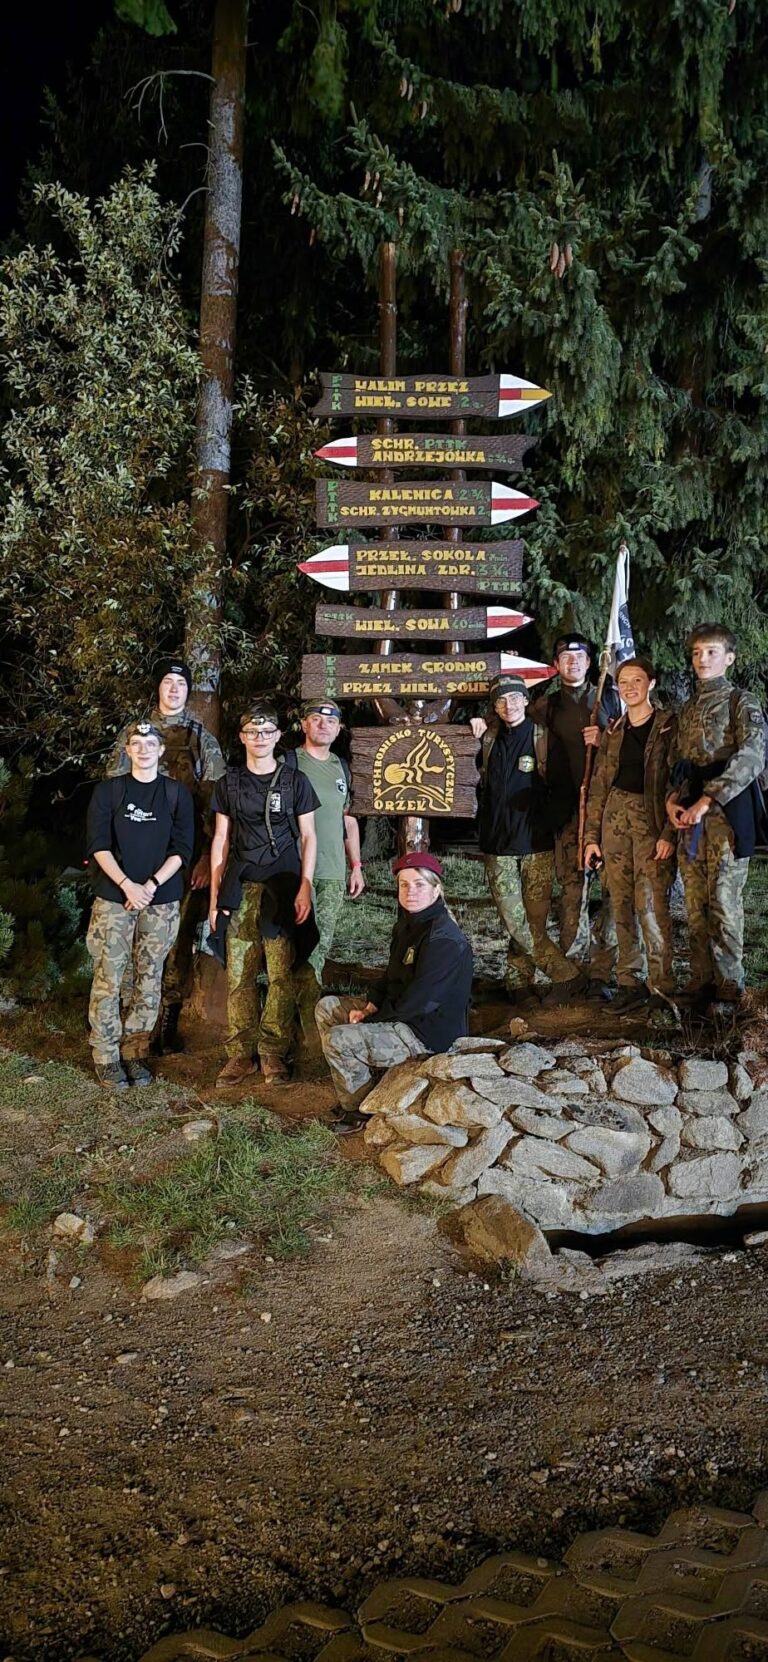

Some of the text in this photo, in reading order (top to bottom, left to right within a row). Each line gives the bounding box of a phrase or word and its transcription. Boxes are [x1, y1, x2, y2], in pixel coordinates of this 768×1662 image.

[331, 375, 342, 410] PTTK
[355, 380, 469, 393] WALIM PRZEZ
[406, 395, 452, 408] SOWE
[371, 438, 467, 450] SCHR. PTTK
[327, 481, 338, 522] PTTK
[369, 489, 454, 501] KALENICA
[340, 506, 381, 516] SCHR.
[356, 550, 417, 562] PRZEŁ.
[421, 550, 486, 561] SOKOLA
[356, 564, 427, 576] JEDLINA
[437, 564, 476, 576] ZDR.
[478, 581, 522, 592] PTTK
[355, 619, 400, 632] WIEL.
[405, 618, 450, 631] SOWA
[358, 660, 487, 675] ZAMEK GRODNO
[325, 656, 337, 697] PTTK
[342, 682, 490, 694] PRZEZ WIEL. SOWE
[373, 729, 455, 804] SCHRONISKO TURYSTYCZNE
